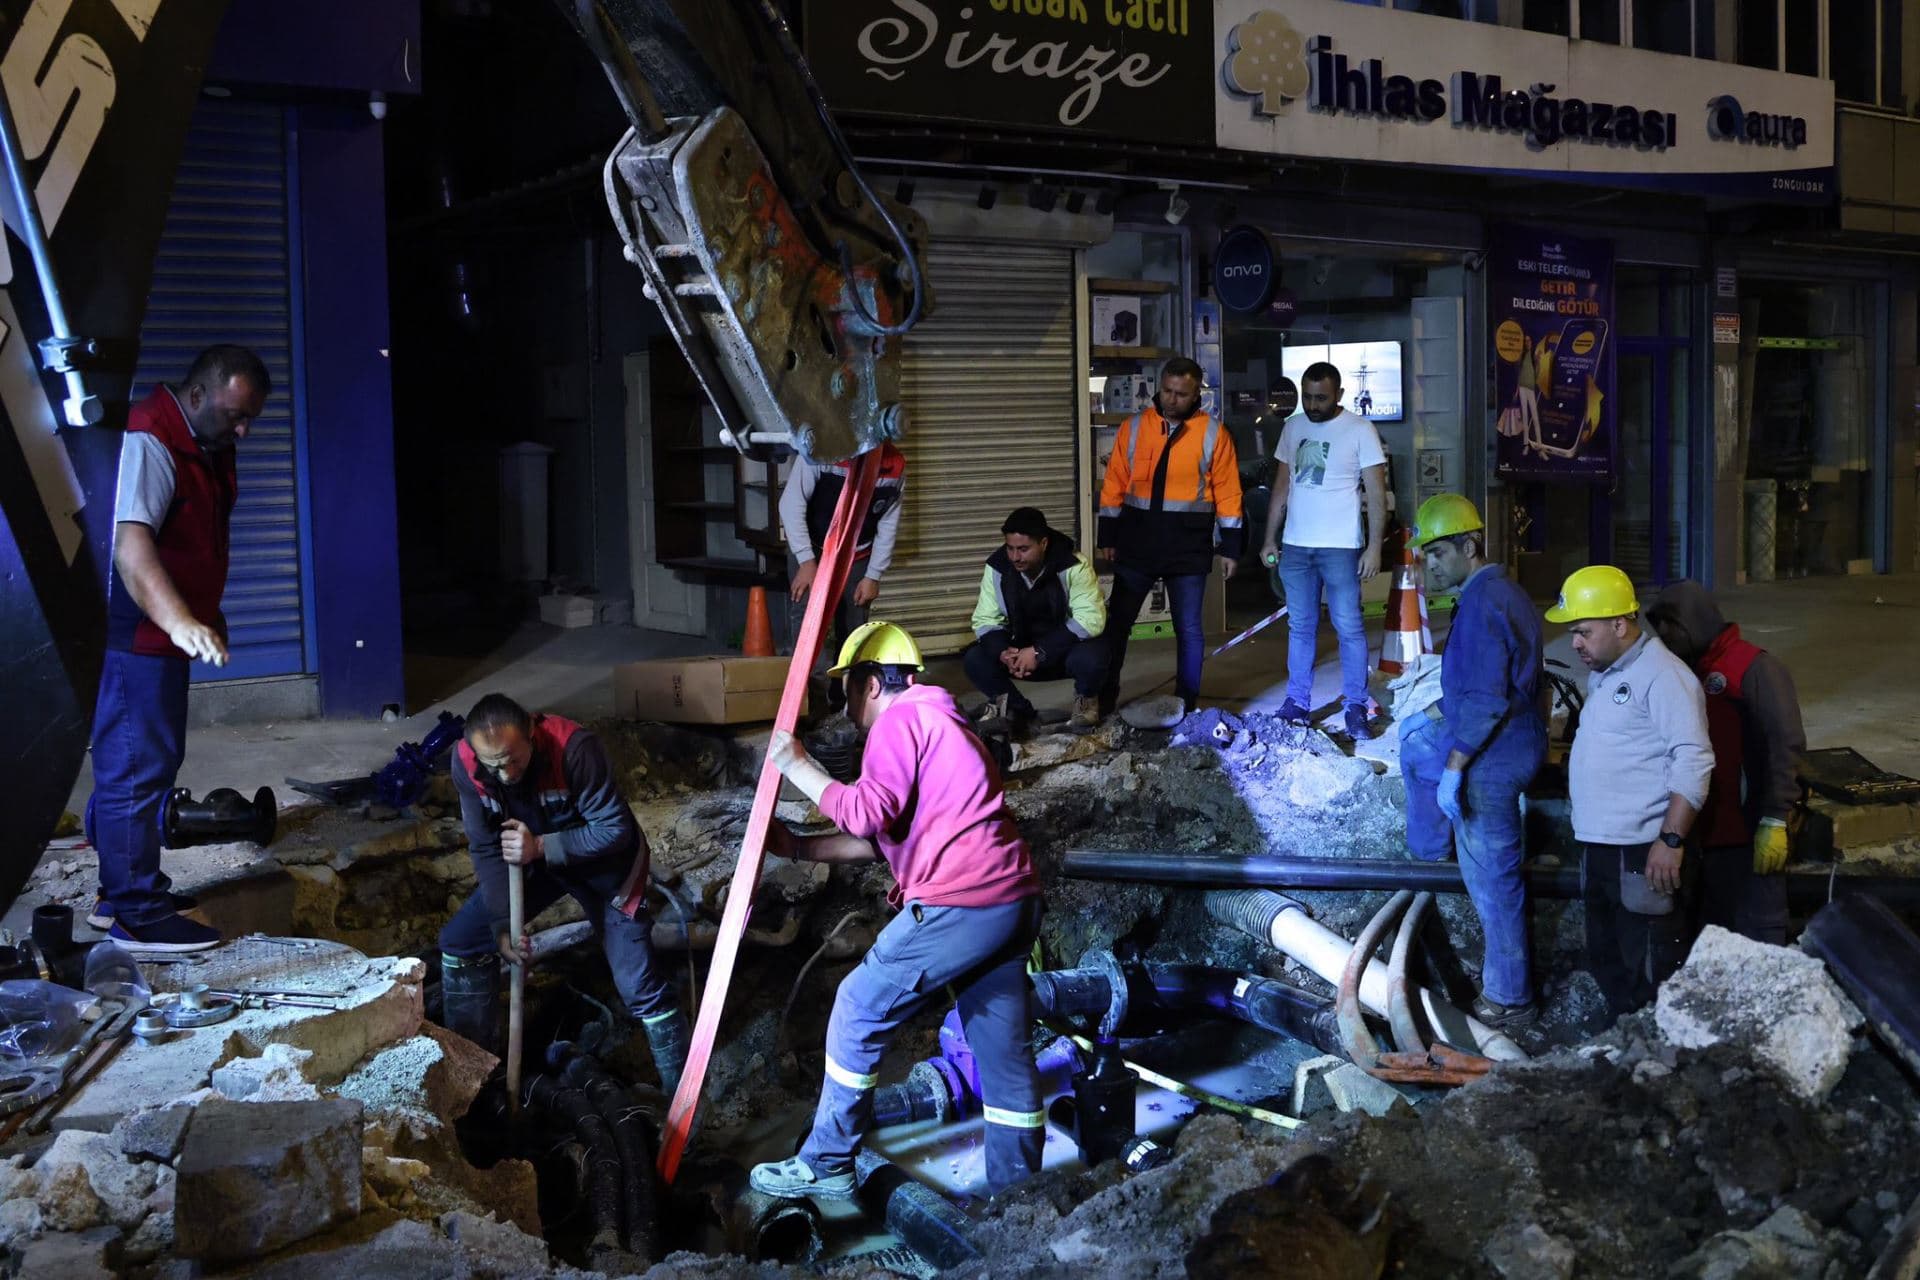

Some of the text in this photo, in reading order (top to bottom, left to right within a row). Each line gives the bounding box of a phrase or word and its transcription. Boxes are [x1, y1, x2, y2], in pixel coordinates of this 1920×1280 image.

[1309, 35, 1677, 151] İhlas Mağazası
[1772, 177, 1824, 192] ZONGULDAK
[1557, 297, 1600, 316] GÖTÜR
